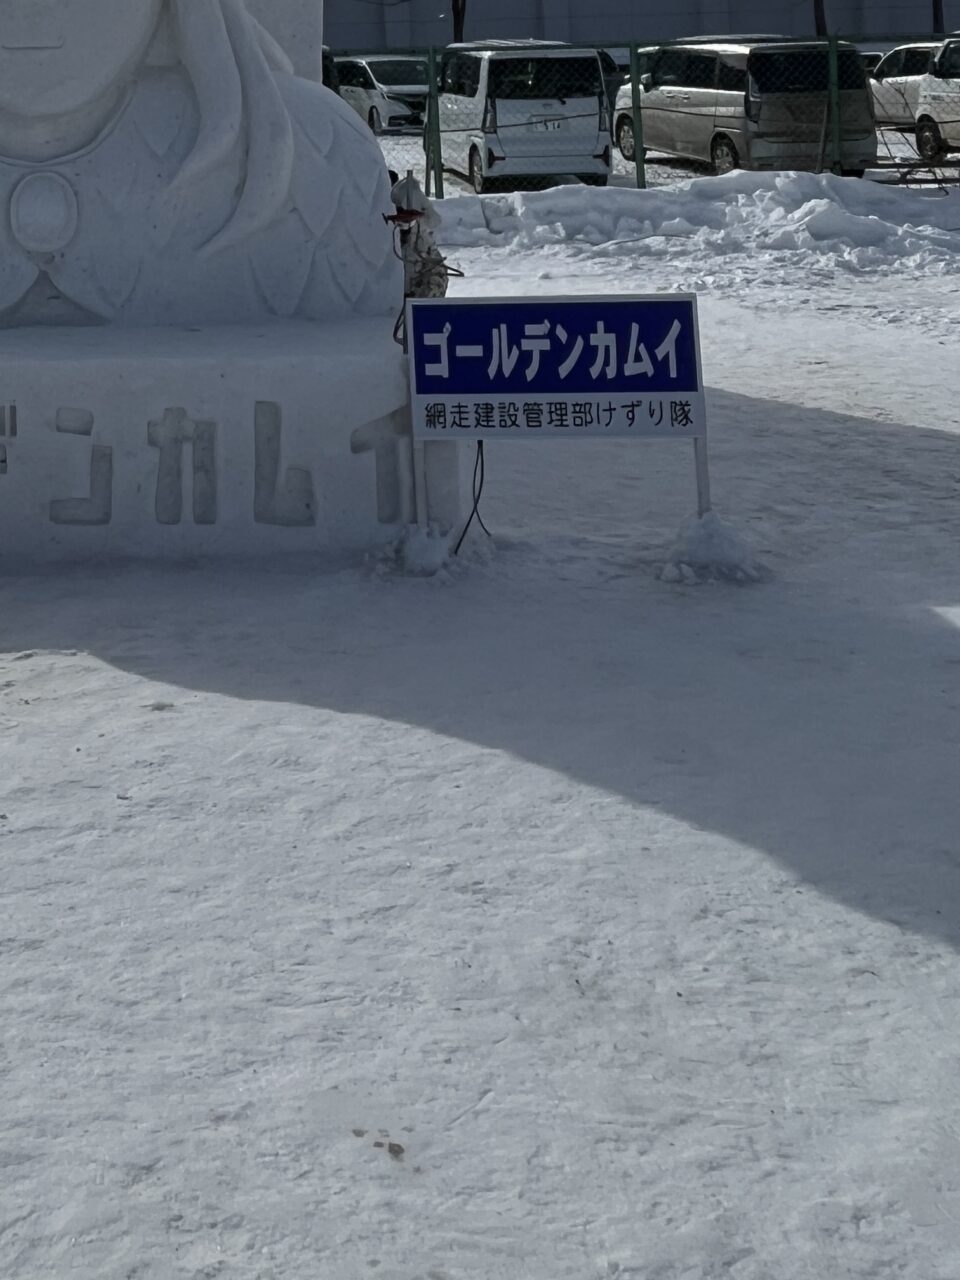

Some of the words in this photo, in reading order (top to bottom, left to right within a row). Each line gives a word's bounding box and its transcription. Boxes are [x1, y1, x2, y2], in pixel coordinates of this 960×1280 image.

[423, 318, 682, 382] ゴールデンカムイ
[424, 400, 694, 429] 網走建設管理部けずり隊
